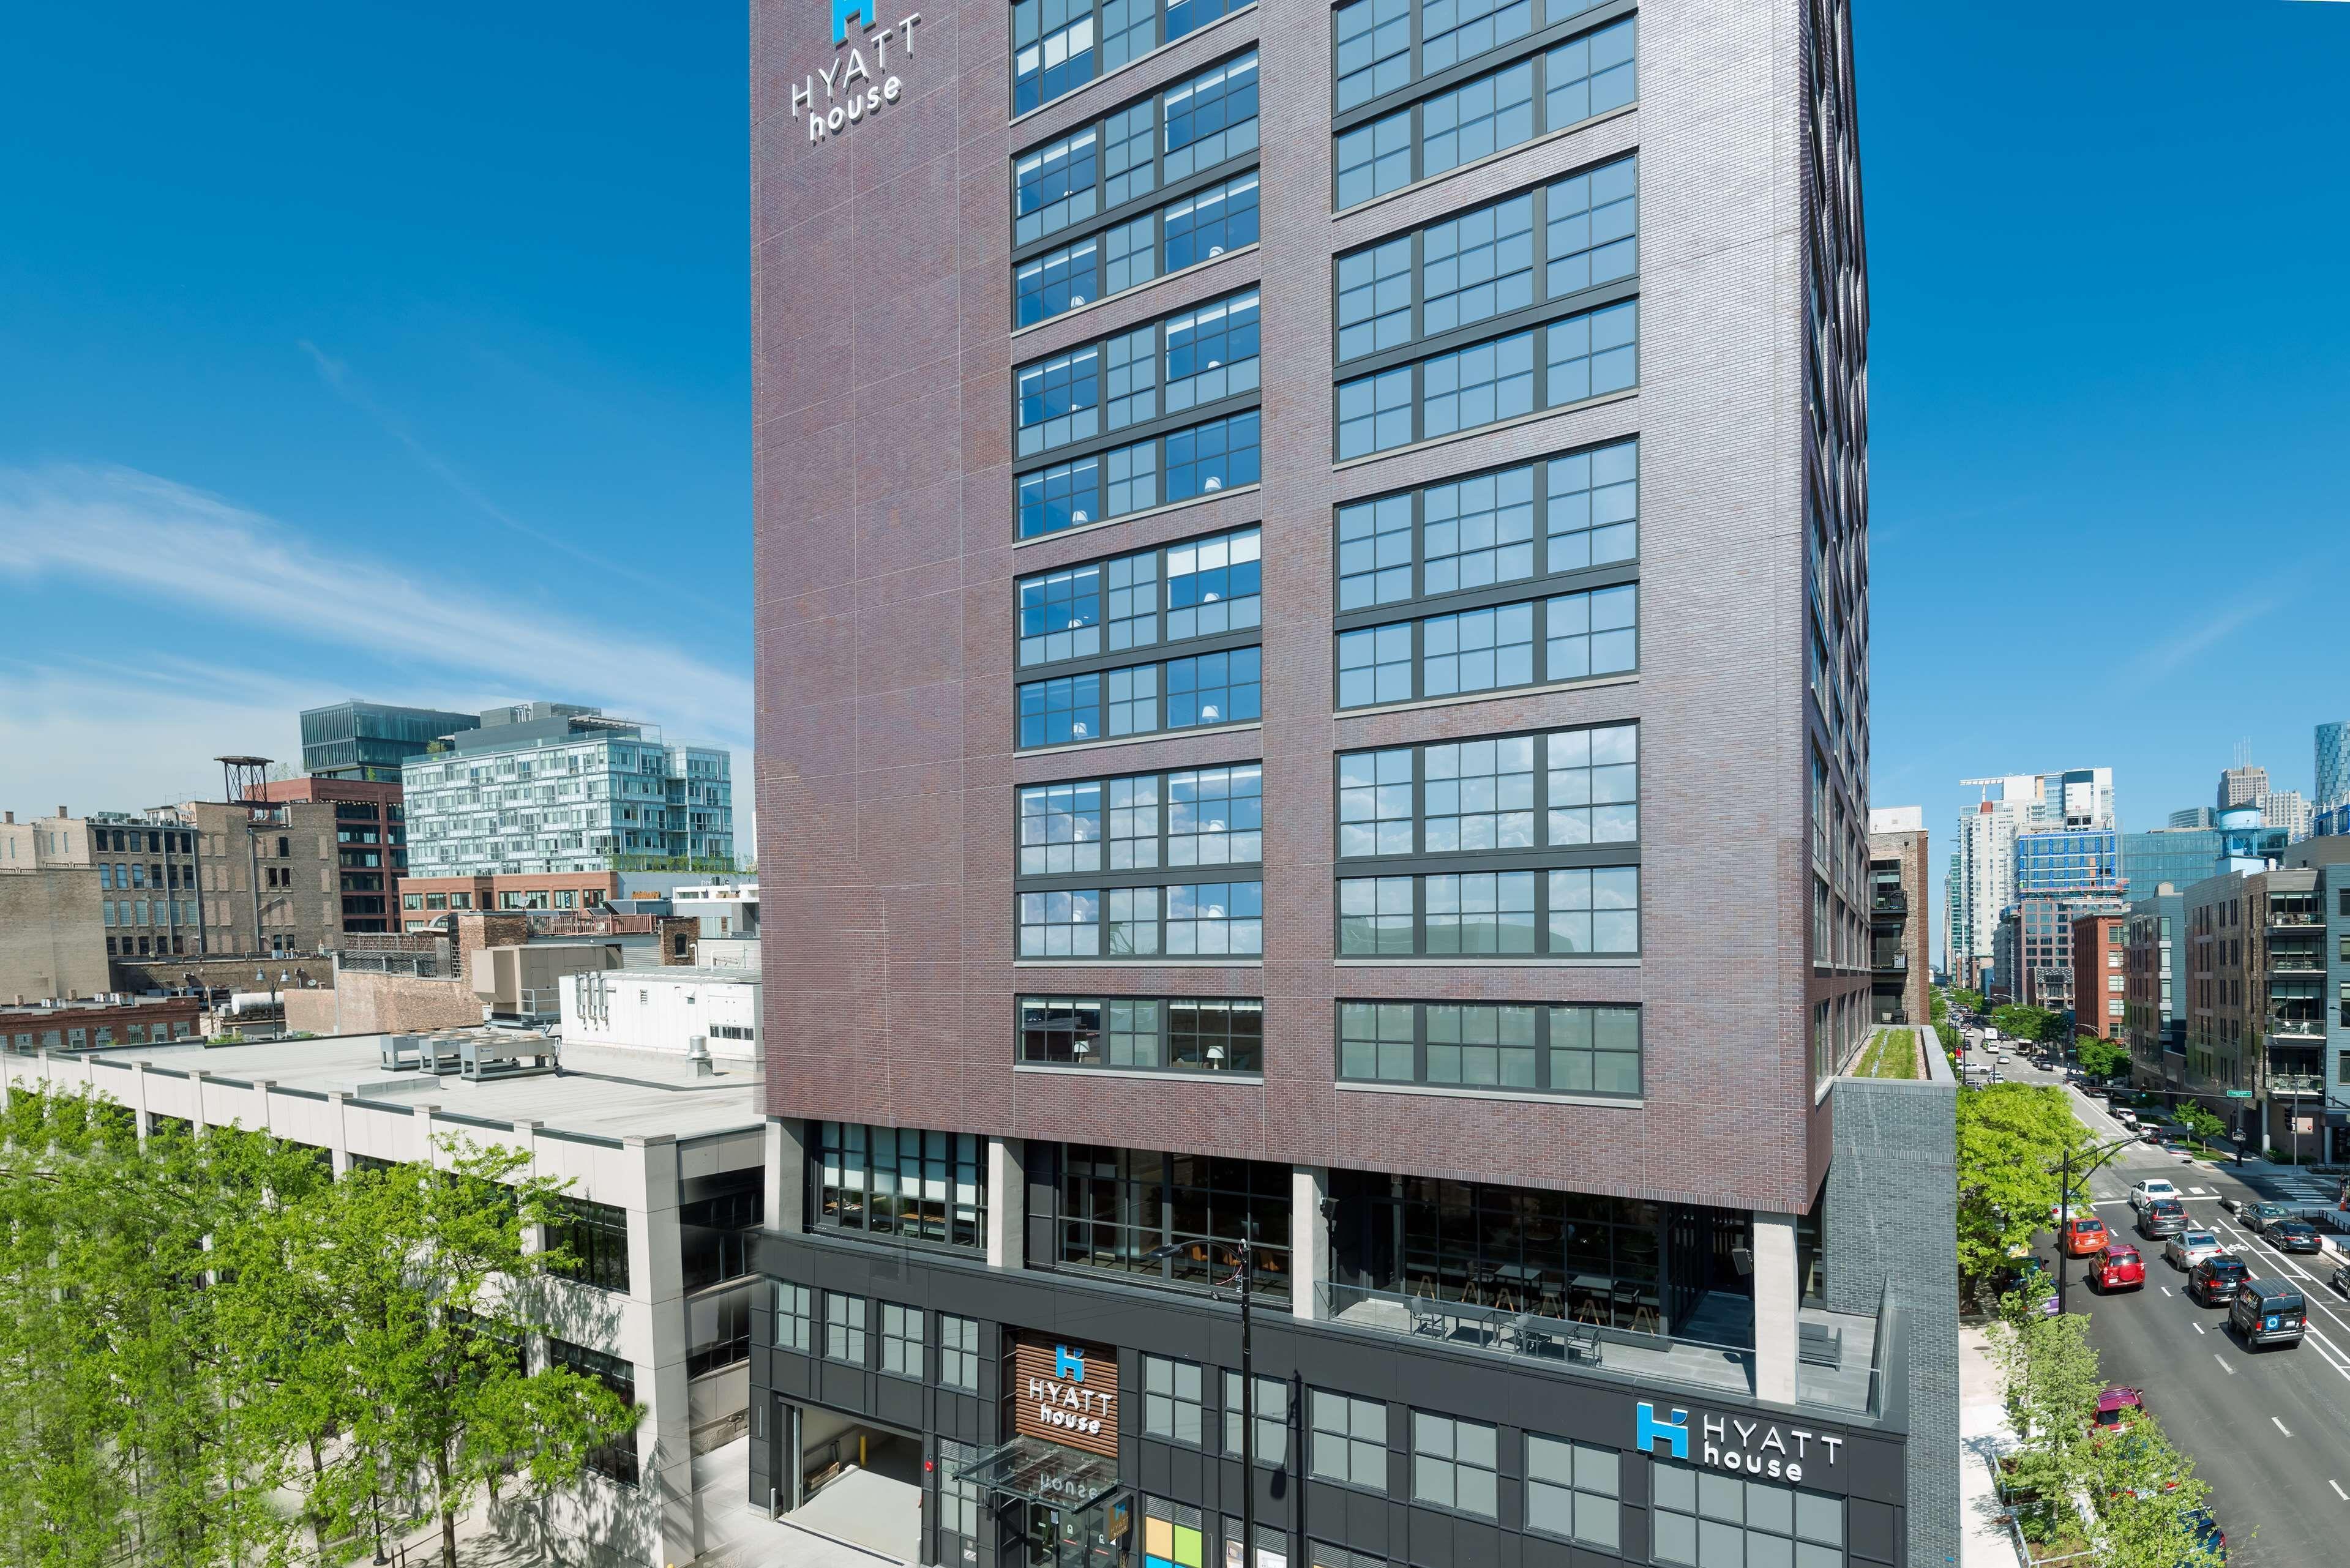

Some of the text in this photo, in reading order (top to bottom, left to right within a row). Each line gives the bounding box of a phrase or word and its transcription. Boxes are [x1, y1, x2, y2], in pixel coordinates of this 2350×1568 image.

[792, 13, 921, 118] HYATT
[809, 76, 902, 142] house
[1029, 1376, 1113, 1416] HYATT
[1041, 1403, 1101, 1434] house
[1704, 1414, 1842, 1465] HYATT
[1704, 1441, 1802, 1482] house
[1110, 1517, 1129, 1533] HYATT
[1113, 1526, 1127, 1537] house
